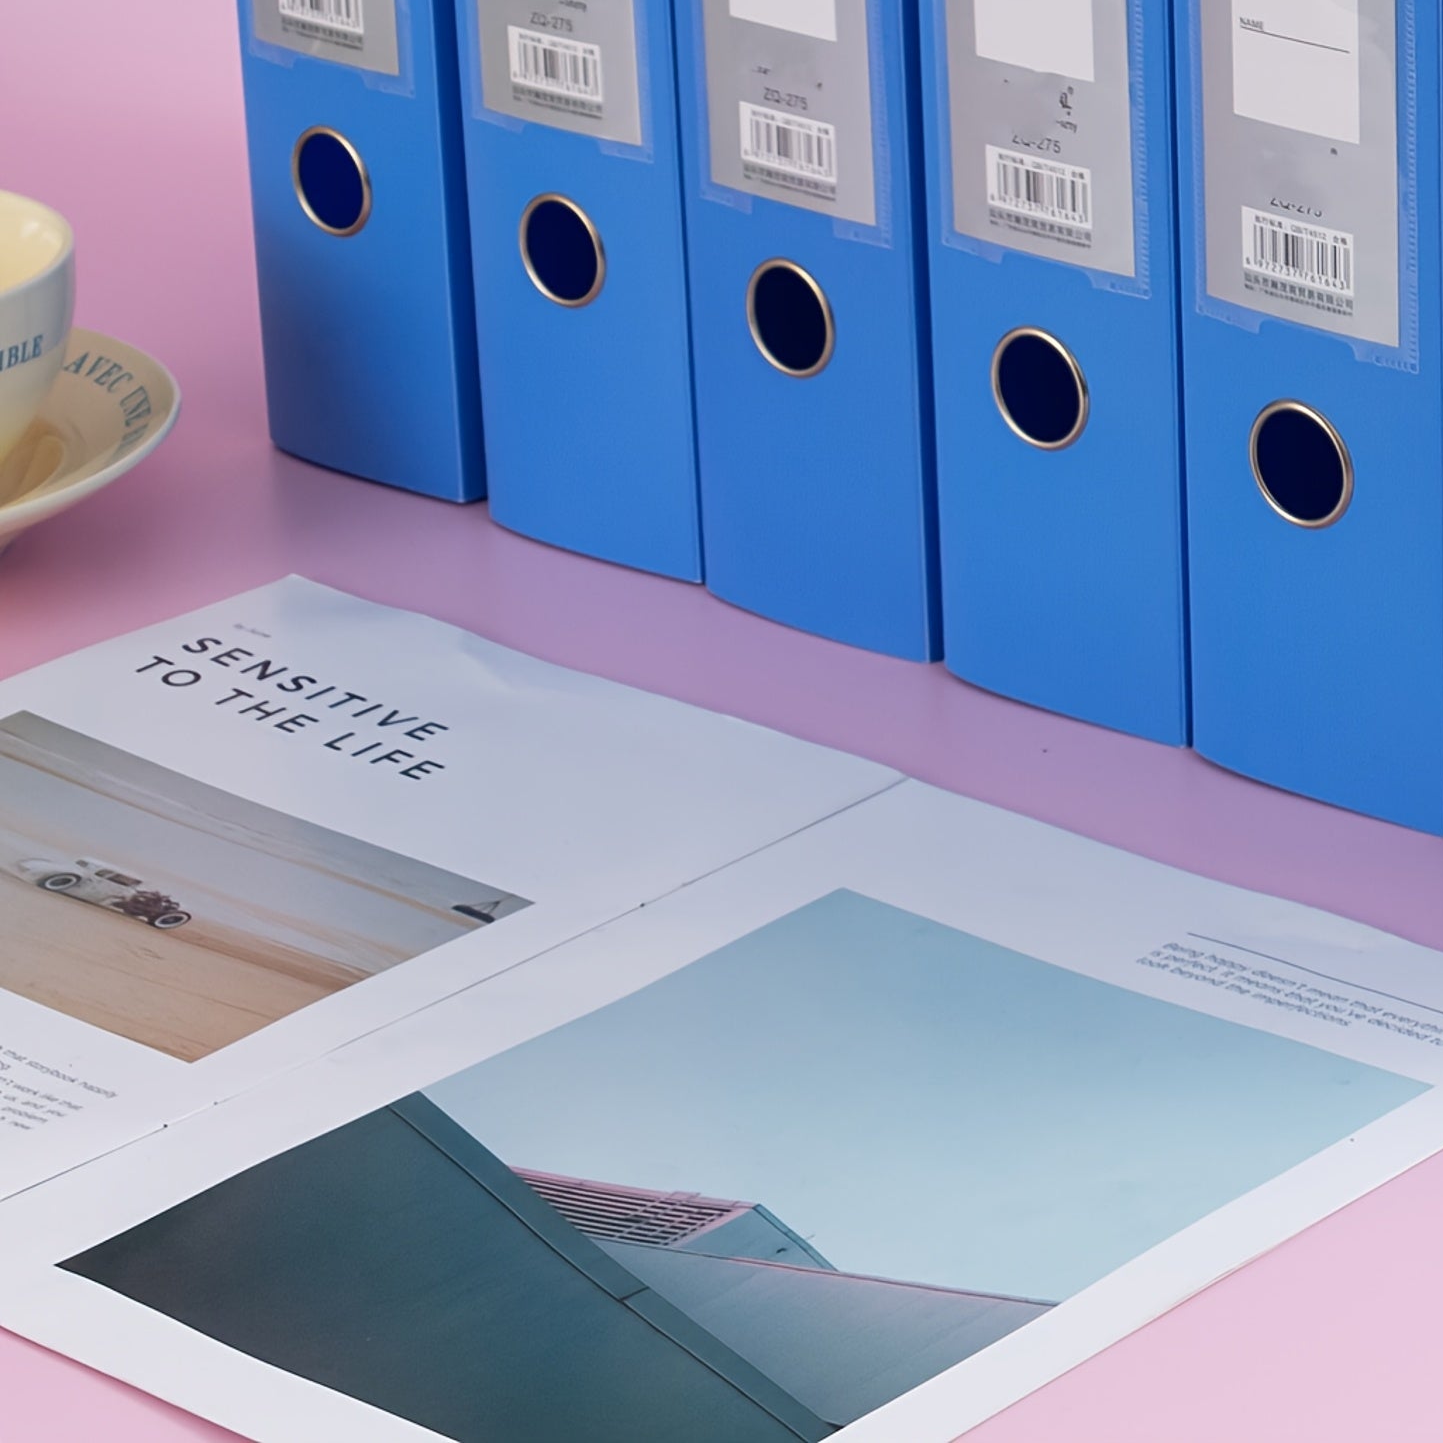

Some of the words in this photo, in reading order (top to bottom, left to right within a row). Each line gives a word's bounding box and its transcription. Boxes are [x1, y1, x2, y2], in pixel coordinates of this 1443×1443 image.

[63, 351, 134, 394] AVEC
[182, 637, 449, 741] SENSITIVE
[135, 655, 202, 687] TO
[215, 688, 319, 733] THE
[323, 732, 446, 780] LIFE
[1136, 957, 1170, 971] look
[1169, 967, 1226, 987] beyond
[1225, 983, 1251, 995] the
[1162, 943, 1205, 958] Being
[1205, 954, 1247, 972] happy
[1367, 1018, 1431, 1041] decided
[25, 1060, 79, 1083] storybook
